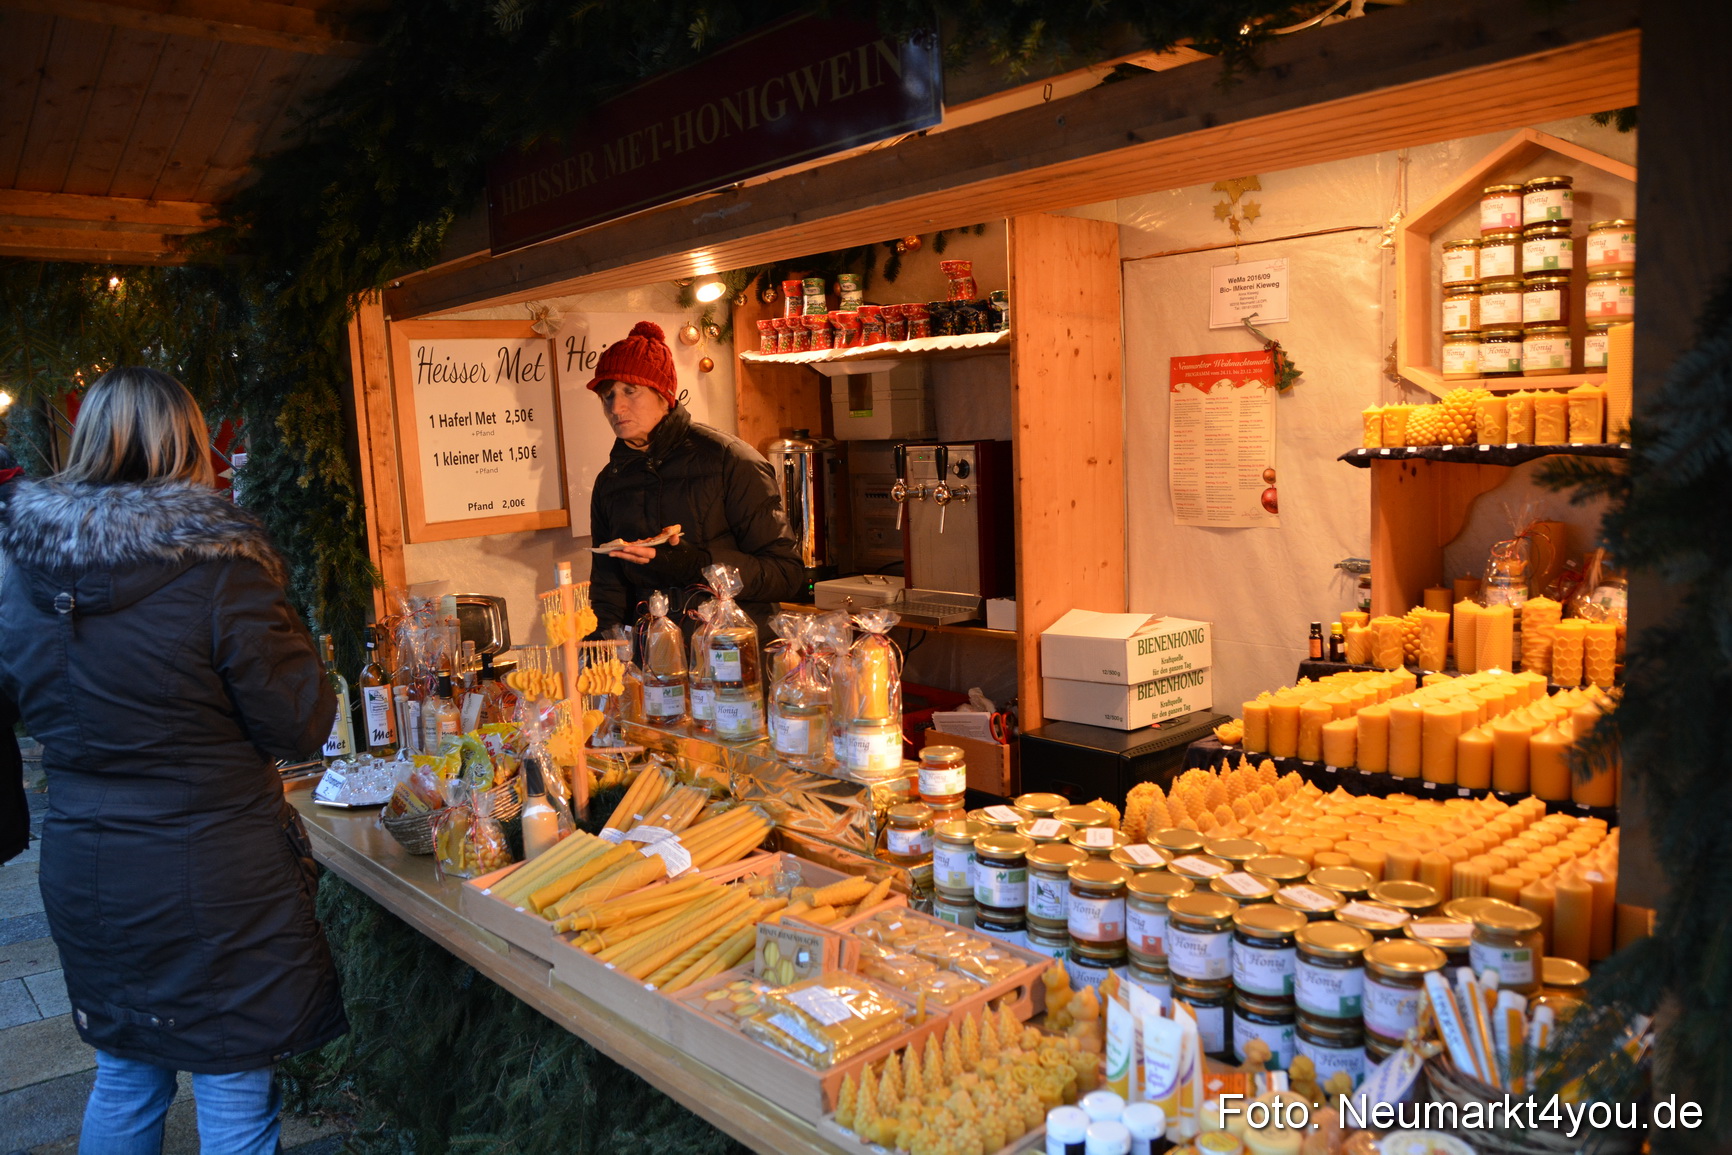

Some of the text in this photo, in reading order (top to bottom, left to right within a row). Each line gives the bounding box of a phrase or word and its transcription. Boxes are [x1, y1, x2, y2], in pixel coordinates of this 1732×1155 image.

[501, 38, 904, 216] HEISSER MET-HONIGWEIN
[1247, 273, 1271, 282] 2016/09
[416, 345, 546, 385] Heisser Met
[1174, 356, 1272, 370] Neumarkter Weihnachtsmarkt
[429, 408, 534, 429] 1 Haferl Met 2,50€
[434, 445, 538, 467] 1 kleiner Met 1,50€
[467, 498, 526, 512] Pfand 2,00€
[1137, 627, 1205, 656] BIENENHONIG
[1161, 654, 1184, 665] Kraftquelle
[1160, 666, 1168, 674] den
[1168, 665, 1183, 673] ganzen
[1184, 661, 1192, 670] Tag
[1137, 670, 1204, 701] BIENENHONIG
[1160, 697, 1183, 708] Kraftquelle
[717, 706, 739, 716] Honig
[1159, 710, 1167, 718] den
[1168, 707, 1183, 716] ganzen
[1183, 704, 1191, 713] Tag
[372, 729, 393, 742] Met
[326, 739, 346, 752] Met
[1073, 902, 1101, 918] Honig
[1175, 937, 1208, 953] Honig
[1248, 953, 1286, 969] Honig
[1304, 971, 1342, 989] Honig
